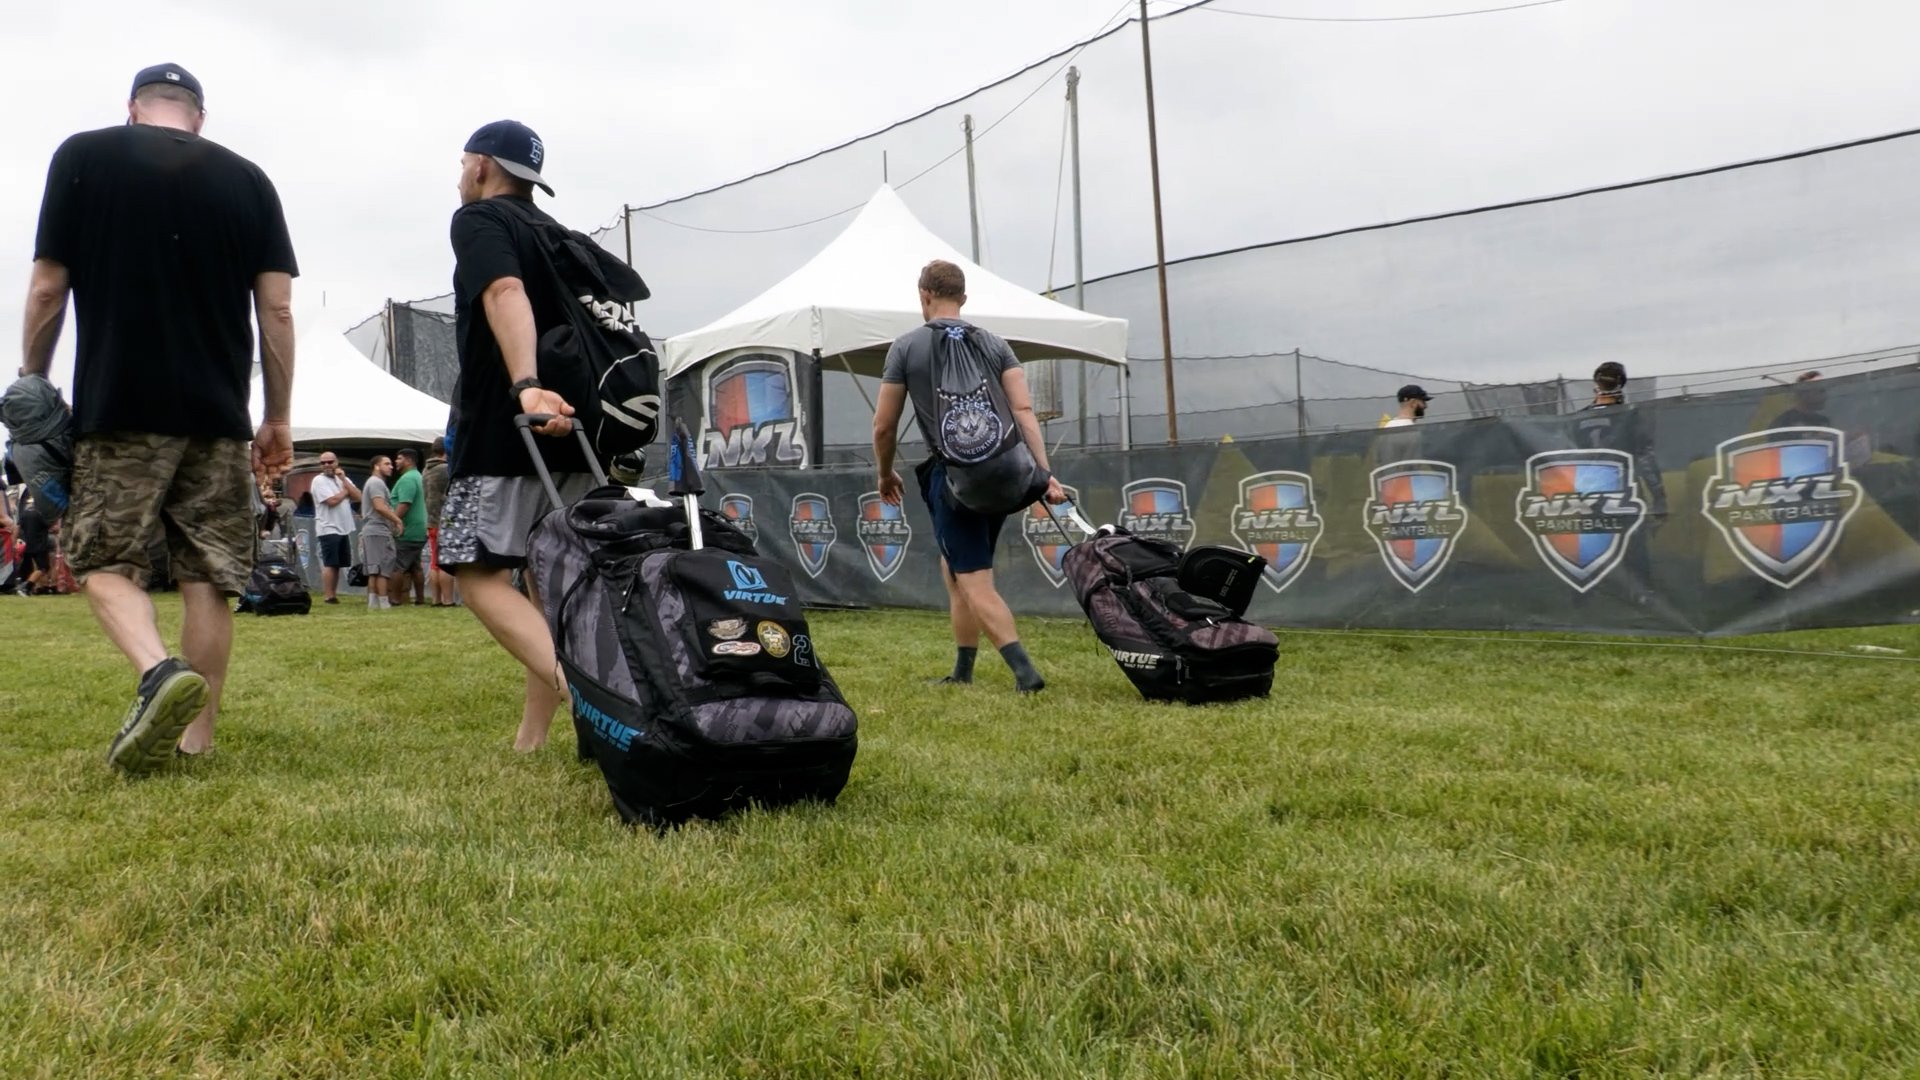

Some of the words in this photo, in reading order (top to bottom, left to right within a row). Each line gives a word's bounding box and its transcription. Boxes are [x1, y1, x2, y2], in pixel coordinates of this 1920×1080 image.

[704, 421, 803, 469] NXL
[1714, 475, 1853, 508] NXL
[1371, 500, 1462, 525] NXL
[1524, 493, 1639, 517] NXL
[1729, 504, 1838, 523] PAINTBALL
[792, 520, 834, 533] NXL
[861, 520, 908, 534] NXL
[1124, 513, 1192, 532] NXL
[1237, 509, 1319, 530] NXL
[1536, 518, 1623, 532] PAINTBALL
[1248, 530, 1310, 541] PAINTBALL
[1381, 524, 1450, 537] PAINTBALL
[723, 590, 787, 606] VIRTUE
[579, 697, 641, 746] VIRTUE
